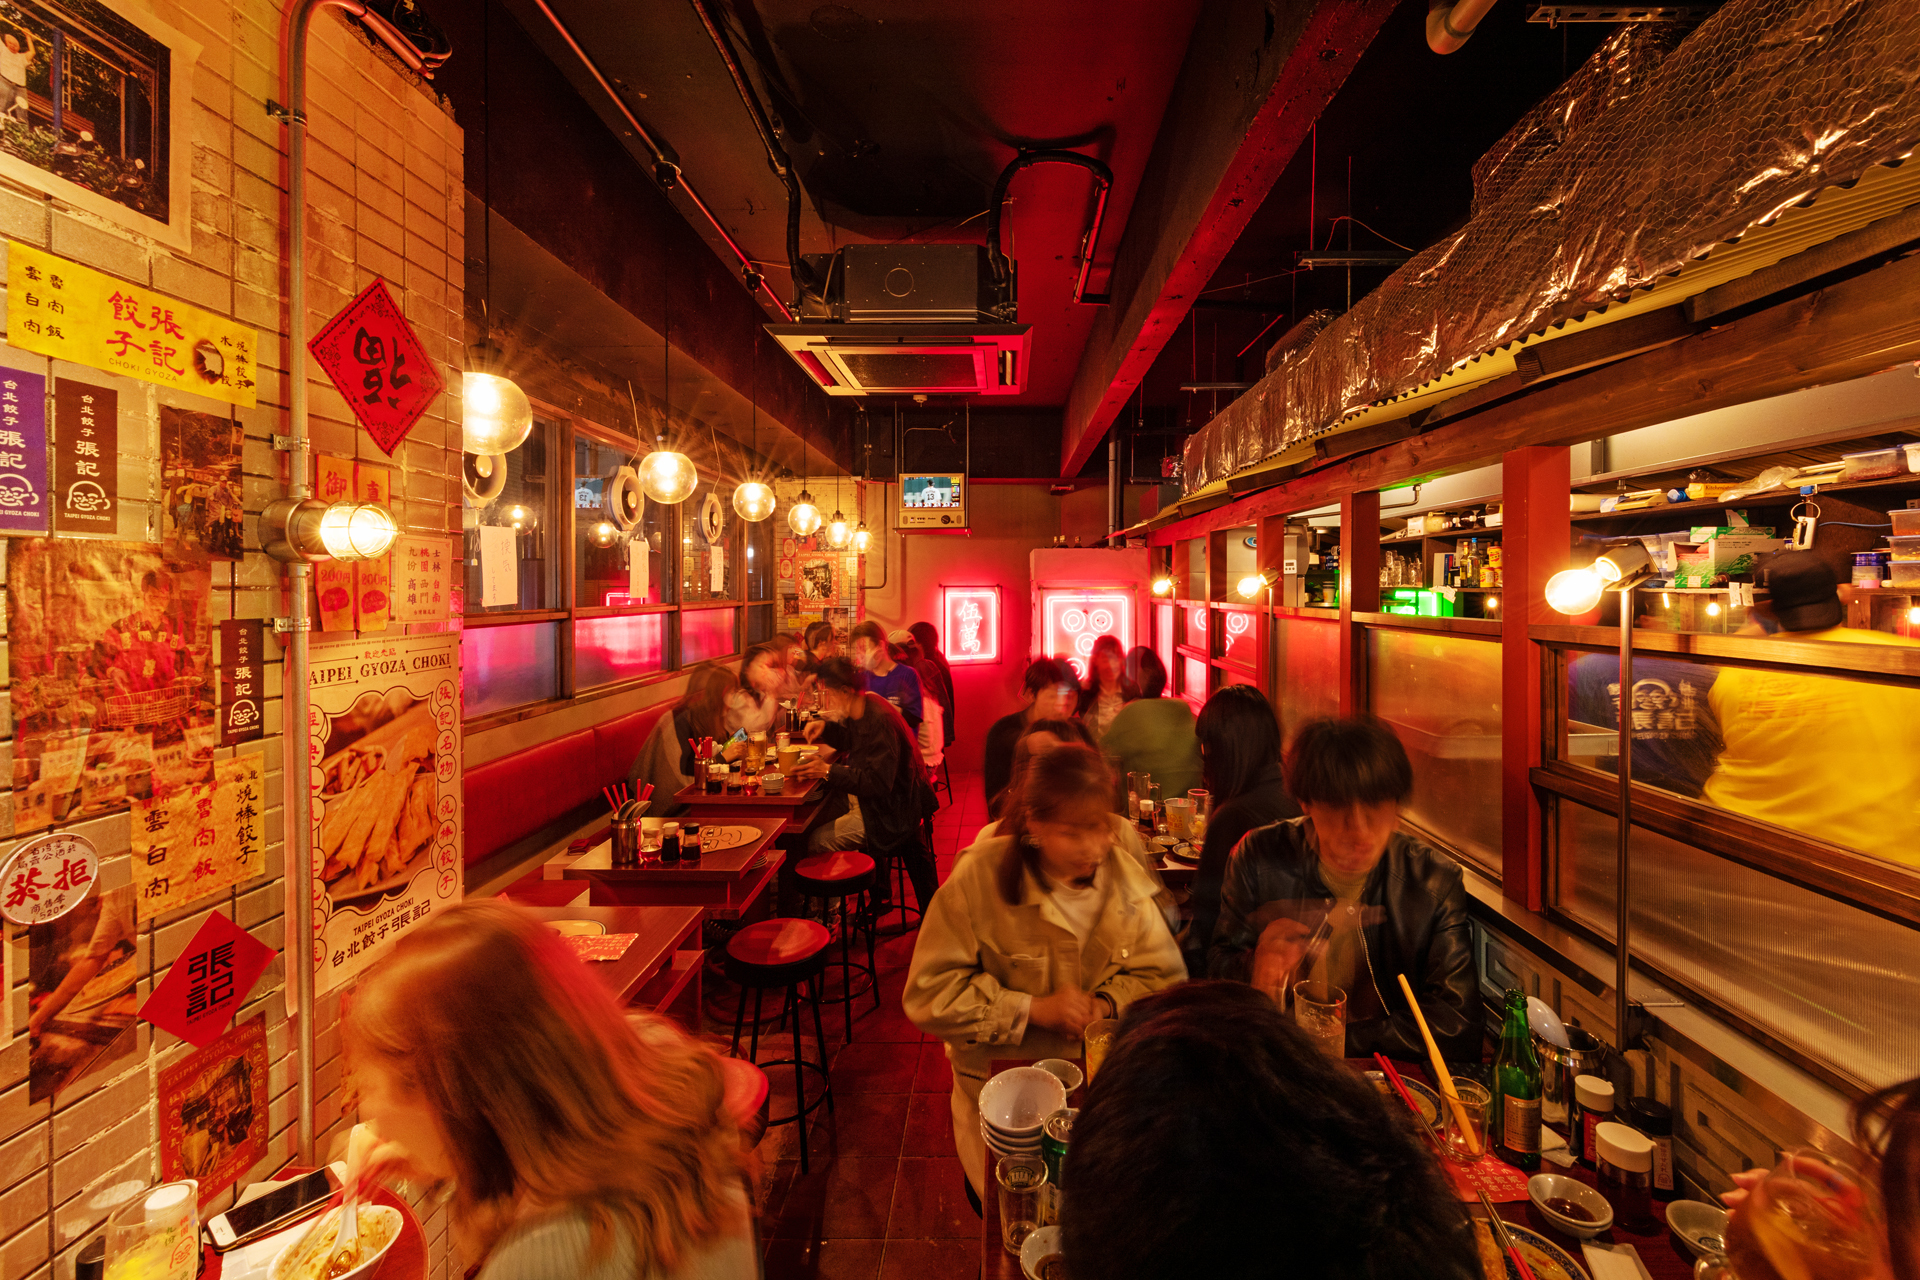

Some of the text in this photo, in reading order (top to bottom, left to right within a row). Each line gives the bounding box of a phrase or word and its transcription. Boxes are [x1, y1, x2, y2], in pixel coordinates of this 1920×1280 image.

[106, 290, 146, 357] 餃子
[149, 305, 185, 376] 張記
[108, 357, 178, 382] CHOKI GYOZA
[927, 493, 935, 501] 13
[958, 599, 983, 652] 伍萬
[309, 653, 451, 686] AIPEI GYOZA CHOKI
[331, 898, 431, 968] 台北餃子張記
[353, 897, 414, 936] TAIPEI GYOZA CHOKI
[186, 939, 236, 1018] 張記
[234, 1023, 262, 1044] CHOKI
